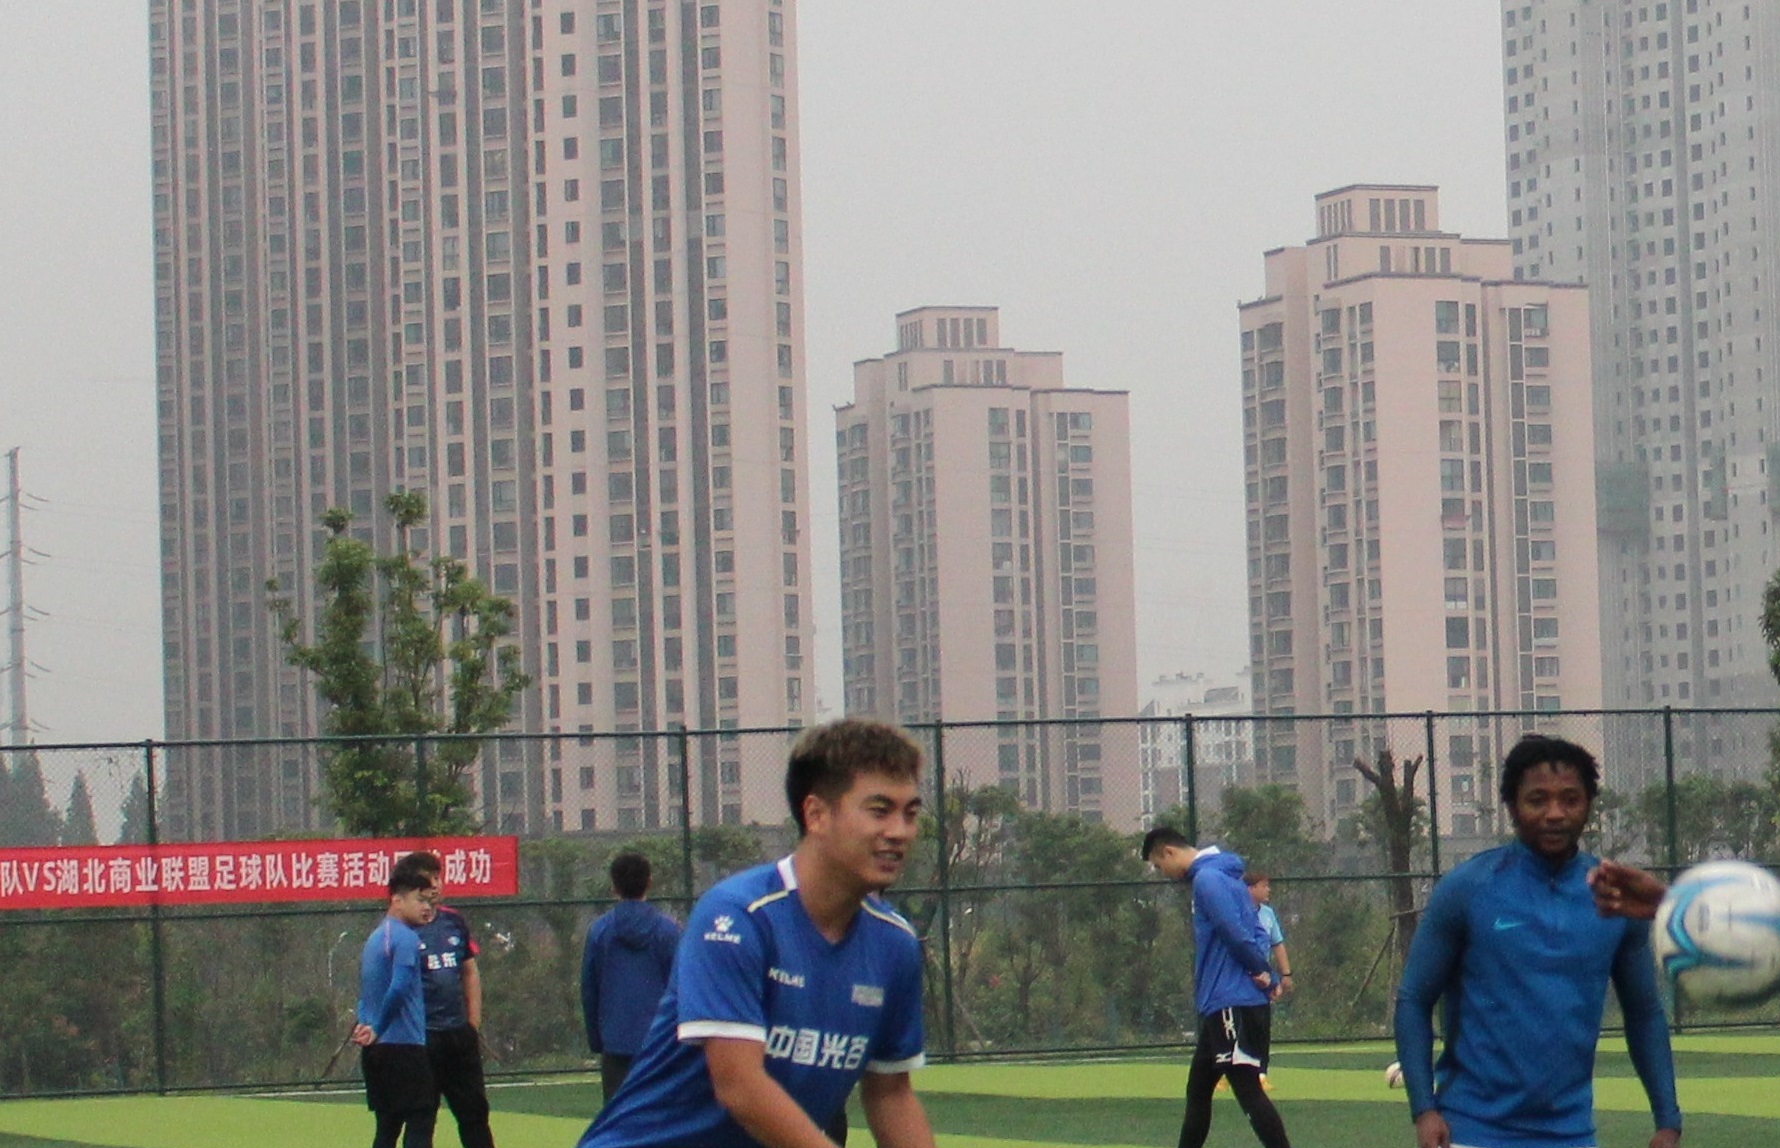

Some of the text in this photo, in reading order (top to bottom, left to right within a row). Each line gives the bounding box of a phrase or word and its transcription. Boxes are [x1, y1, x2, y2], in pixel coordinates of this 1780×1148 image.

[1, 849, 491, 897] 队VS湖北商业联盟足球队比赛活动成功
